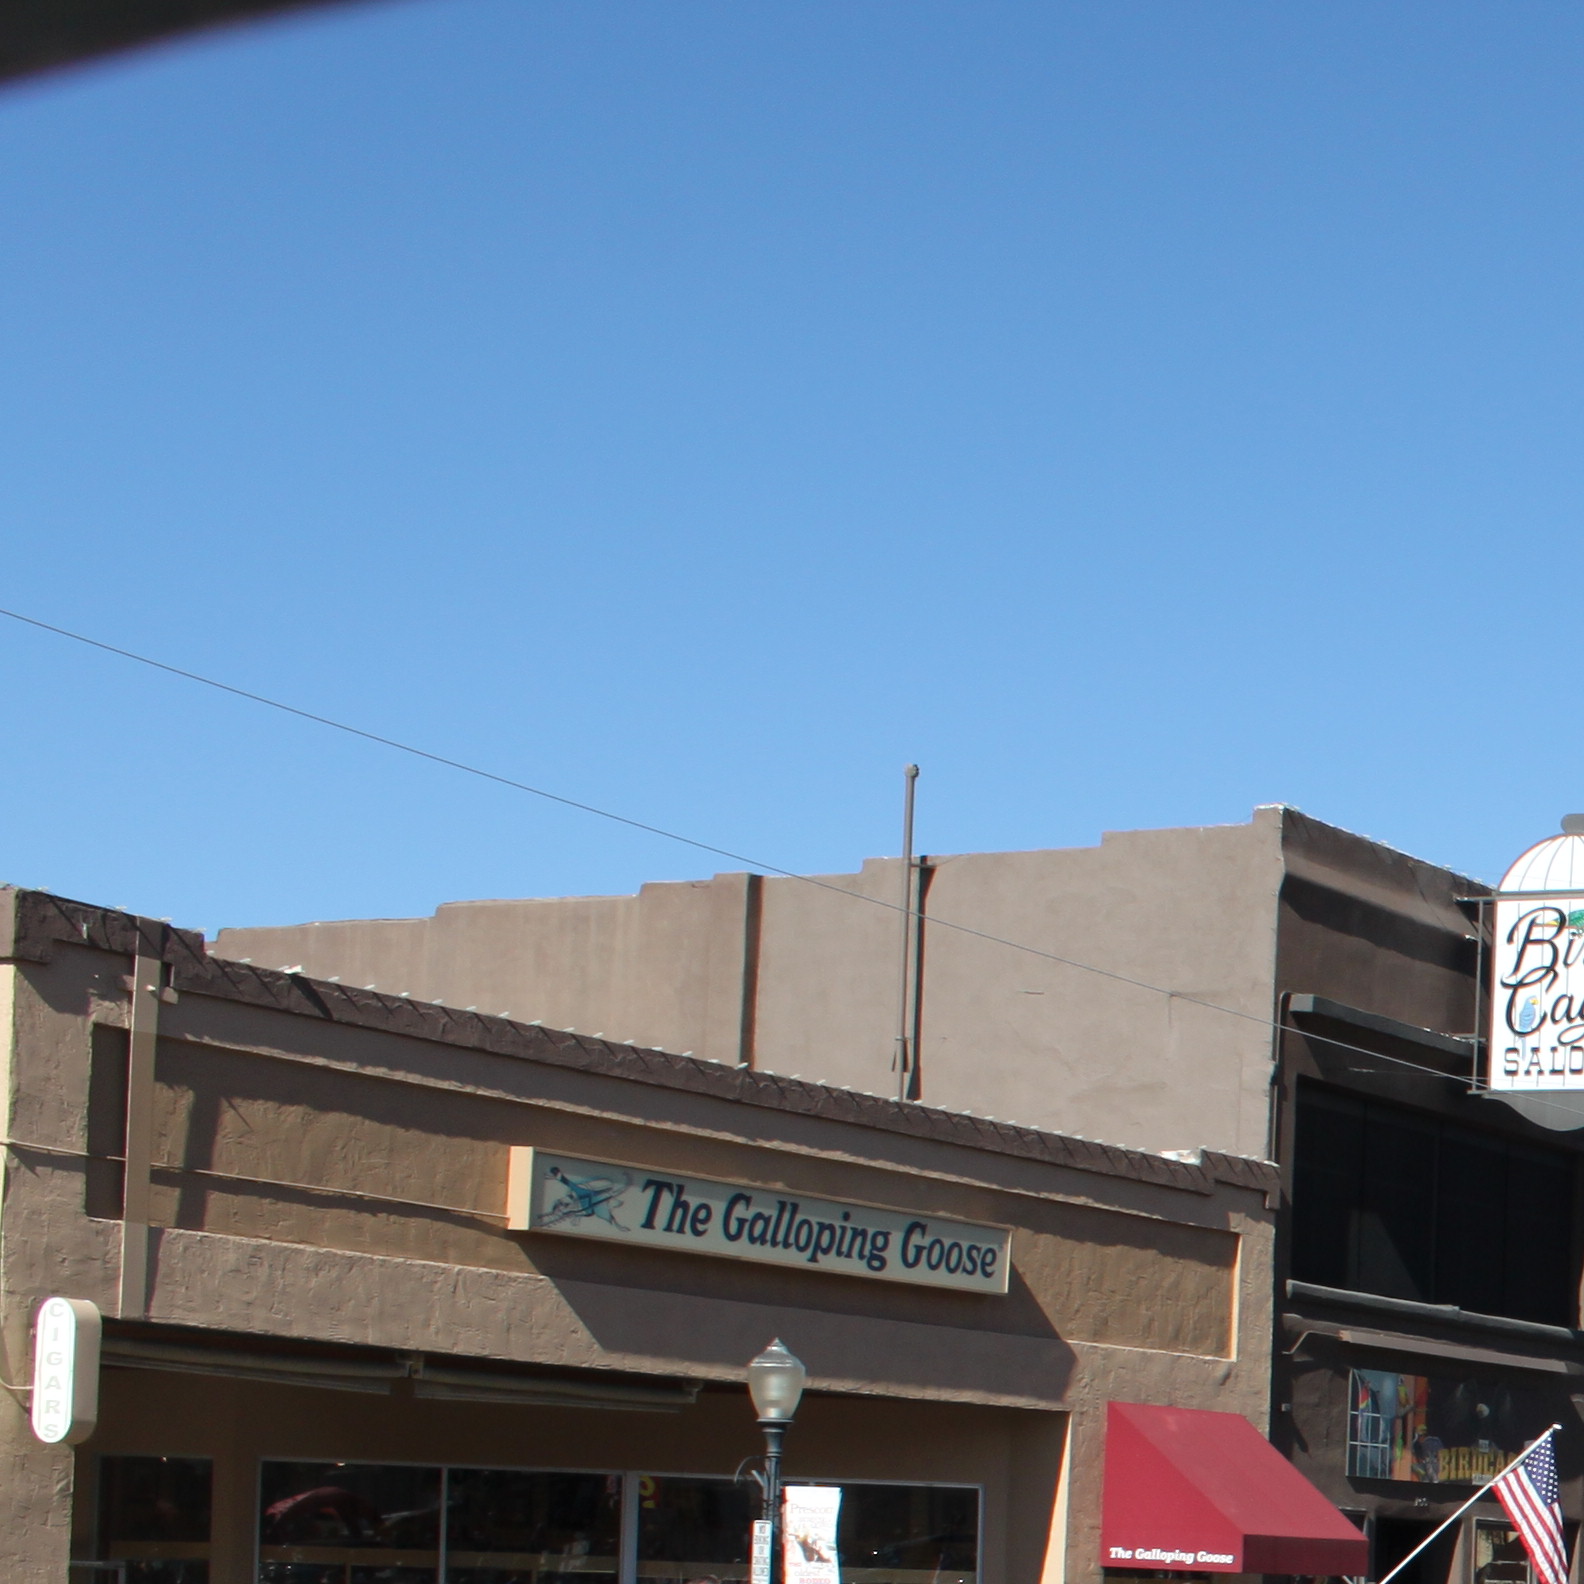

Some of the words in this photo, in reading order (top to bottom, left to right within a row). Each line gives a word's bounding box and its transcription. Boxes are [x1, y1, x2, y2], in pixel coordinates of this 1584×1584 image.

[640, 1178, 712, 1237] The
[722, 1193, 892, 1272] Galloping
[901, 1220, 998, 1279] Goose
[43, 1303, 64, 1438] CIGARS
[1109, 1547, 1132, 1559] The
[1135, 1548, 1195, 1564] Galloping
[1197, 1551, 1234, 1564] Goose
